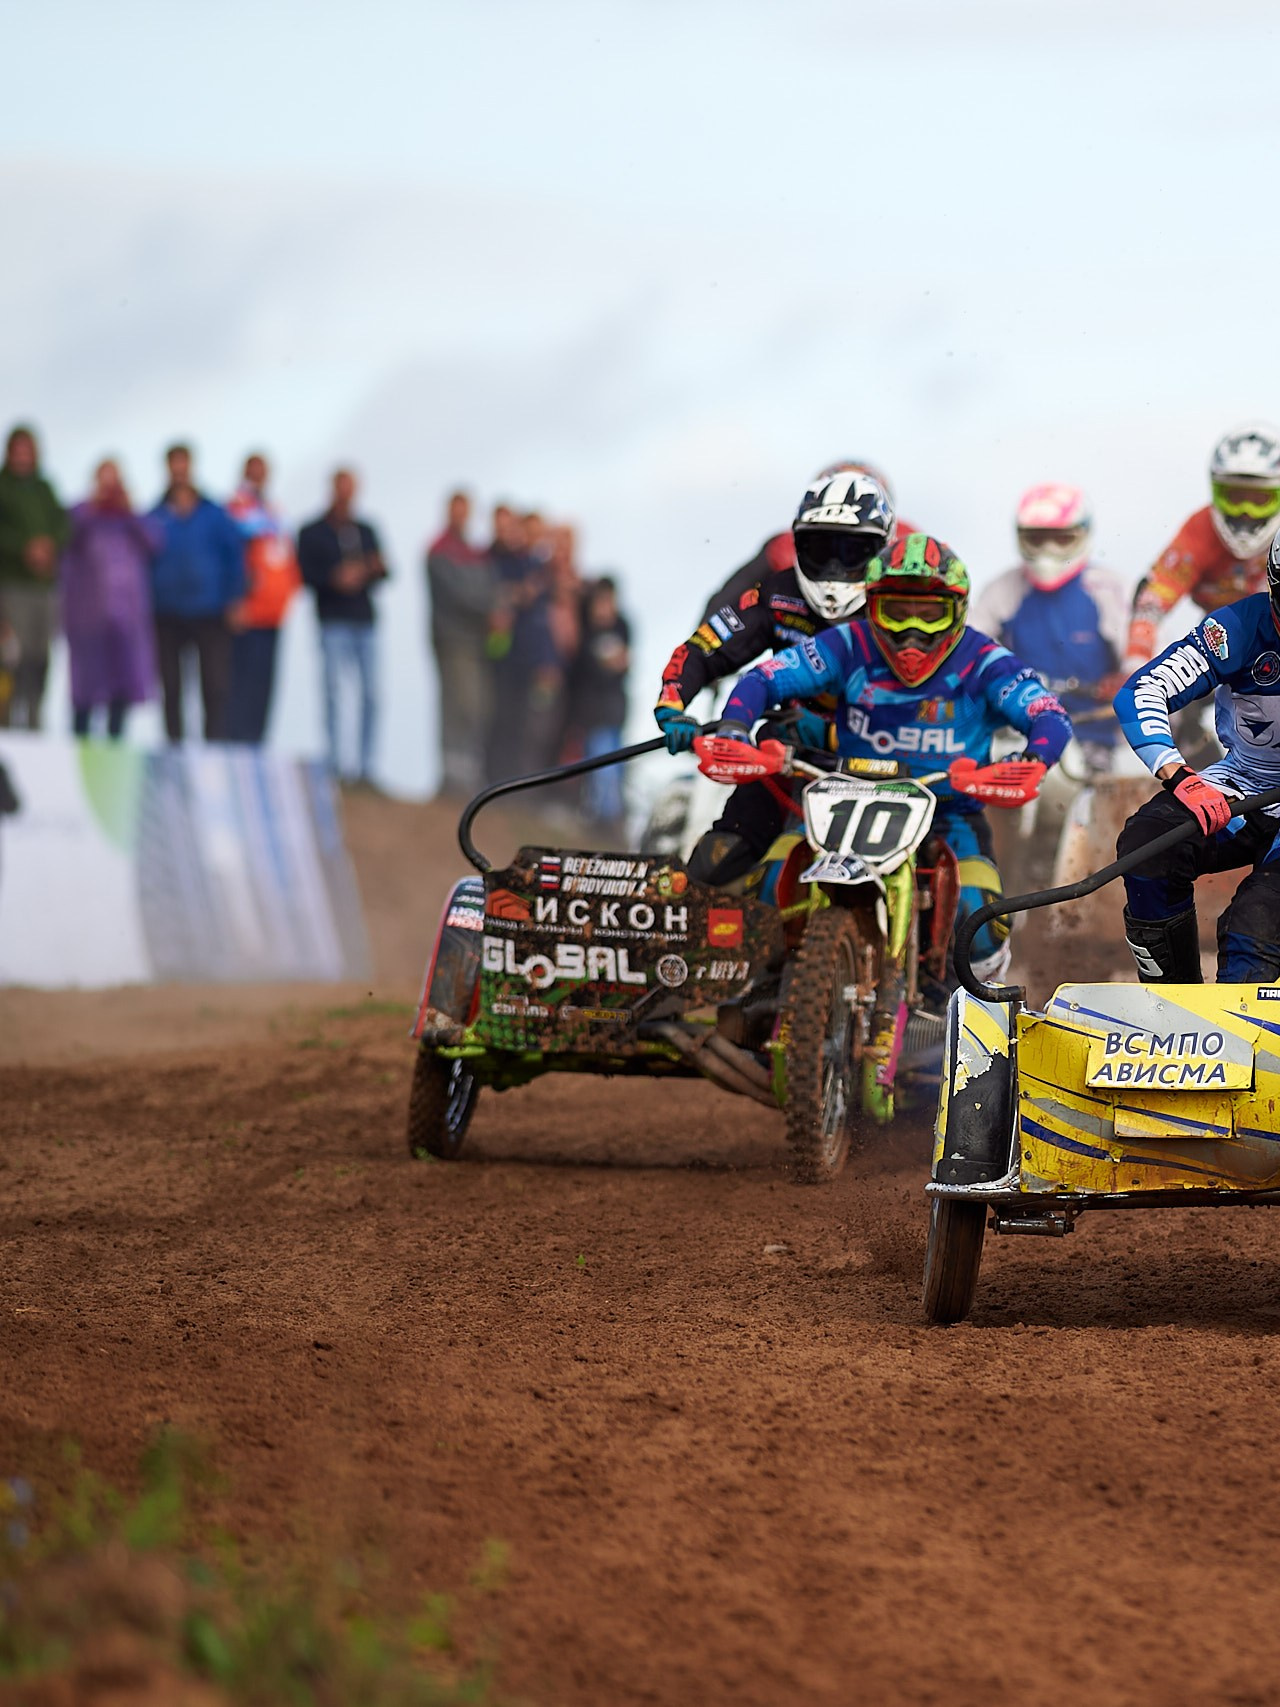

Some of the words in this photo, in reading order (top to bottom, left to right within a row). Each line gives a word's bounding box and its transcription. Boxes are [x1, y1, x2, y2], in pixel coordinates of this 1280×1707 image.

[847, 706, 966, 754] GLOBAL
[824, 800, 912, 857] 10
[536, 896, 688, 932] ИСКОН
[484, 934, 647, 988] GLOBAL
[1105, 1031, 1224, 1057] ВСМПО
[1092, 1062, 1227, 1085] АВИСМА
